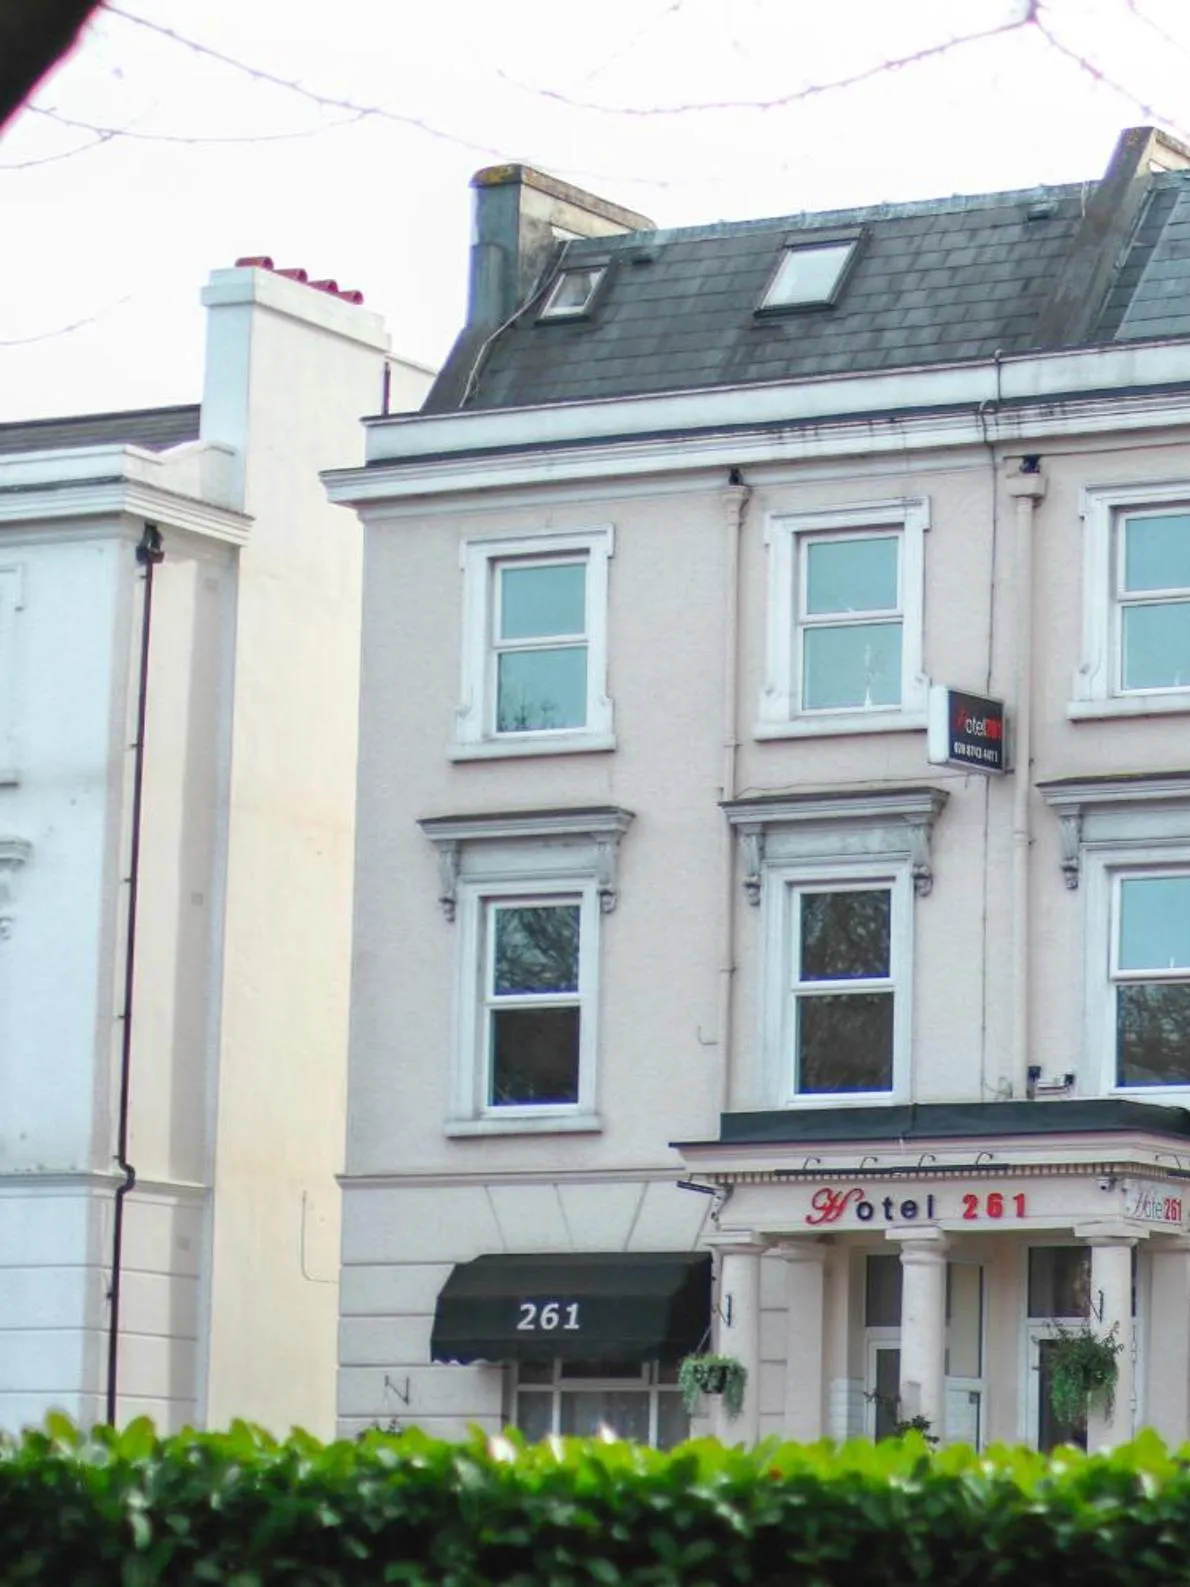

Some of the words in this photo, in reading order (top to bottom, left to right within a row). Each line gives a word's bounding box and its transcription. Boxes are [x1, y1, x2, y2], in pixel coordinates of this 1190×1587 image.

[805, 1187, 934, 1225] Hotel
[962, 1193, 1025, 1219] 261
[1133, 1190, 1164, 1219] Hote
[517, 1302, 580, 1330] 261
